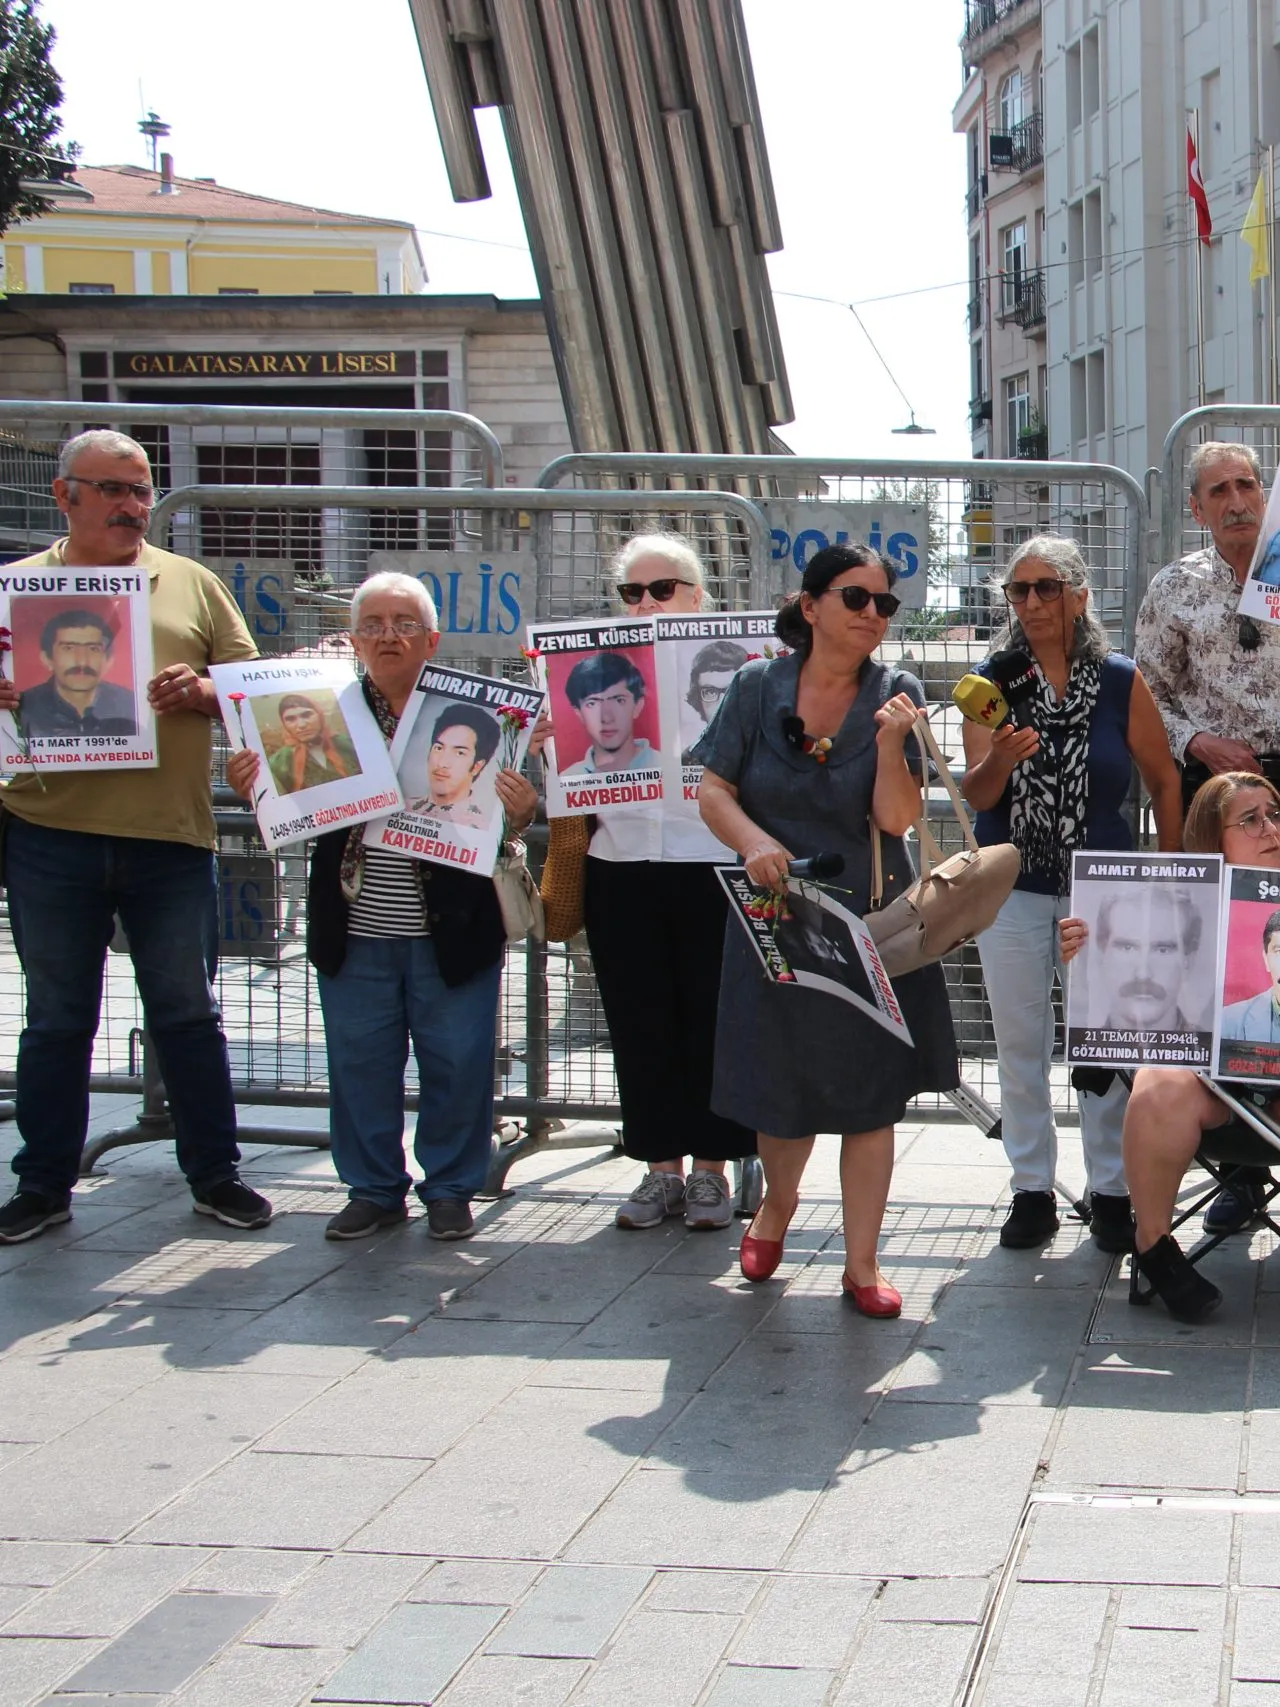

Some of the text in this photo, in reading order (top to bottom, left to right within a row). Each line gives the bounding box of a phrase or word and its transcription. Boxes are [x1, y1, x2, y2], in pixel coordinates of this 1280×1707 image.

[130, 352, 398, 374] GALATASARAY LİSESİ
[0, 574, 142, 595] YUSUF ERİŞTİ
[1257, 584, 1263, 592] 8
[658, 617, 776, 637] HAYRETTİN ERE
[537, 633, 595, 651] ZEYNEL
[242, 669, 292, 682] HATUN
[420, 671, 541, 713] MURAT YILDIZ
[30, 739, 44, 748] 14
[48, 738, 81, 748] MART
[6, 750, 154, 764] GÖZALTINDA KAYBEDİLDİ
[606, 770, 663, 784] GÖZALTIND
[566, 780, 664, 808] KAYBEDİLDİ
[315, 804, 358, 826] GÖZALTINDA
[358, 788, 399, 813] KAYBEDİLDİ
[387, 818, 438, 839] GÖZALTINDA
[381, 828, 479, 866] KAYBEDİLDİ
[1088, 864, 1137, 876] AHMET
[1084, 1030, 1097, 1041] 21
[1101, 1030, 1158, 1043] TEMMUZ
[1072, 1044, 1139, 1059] GÖZALTINDA
